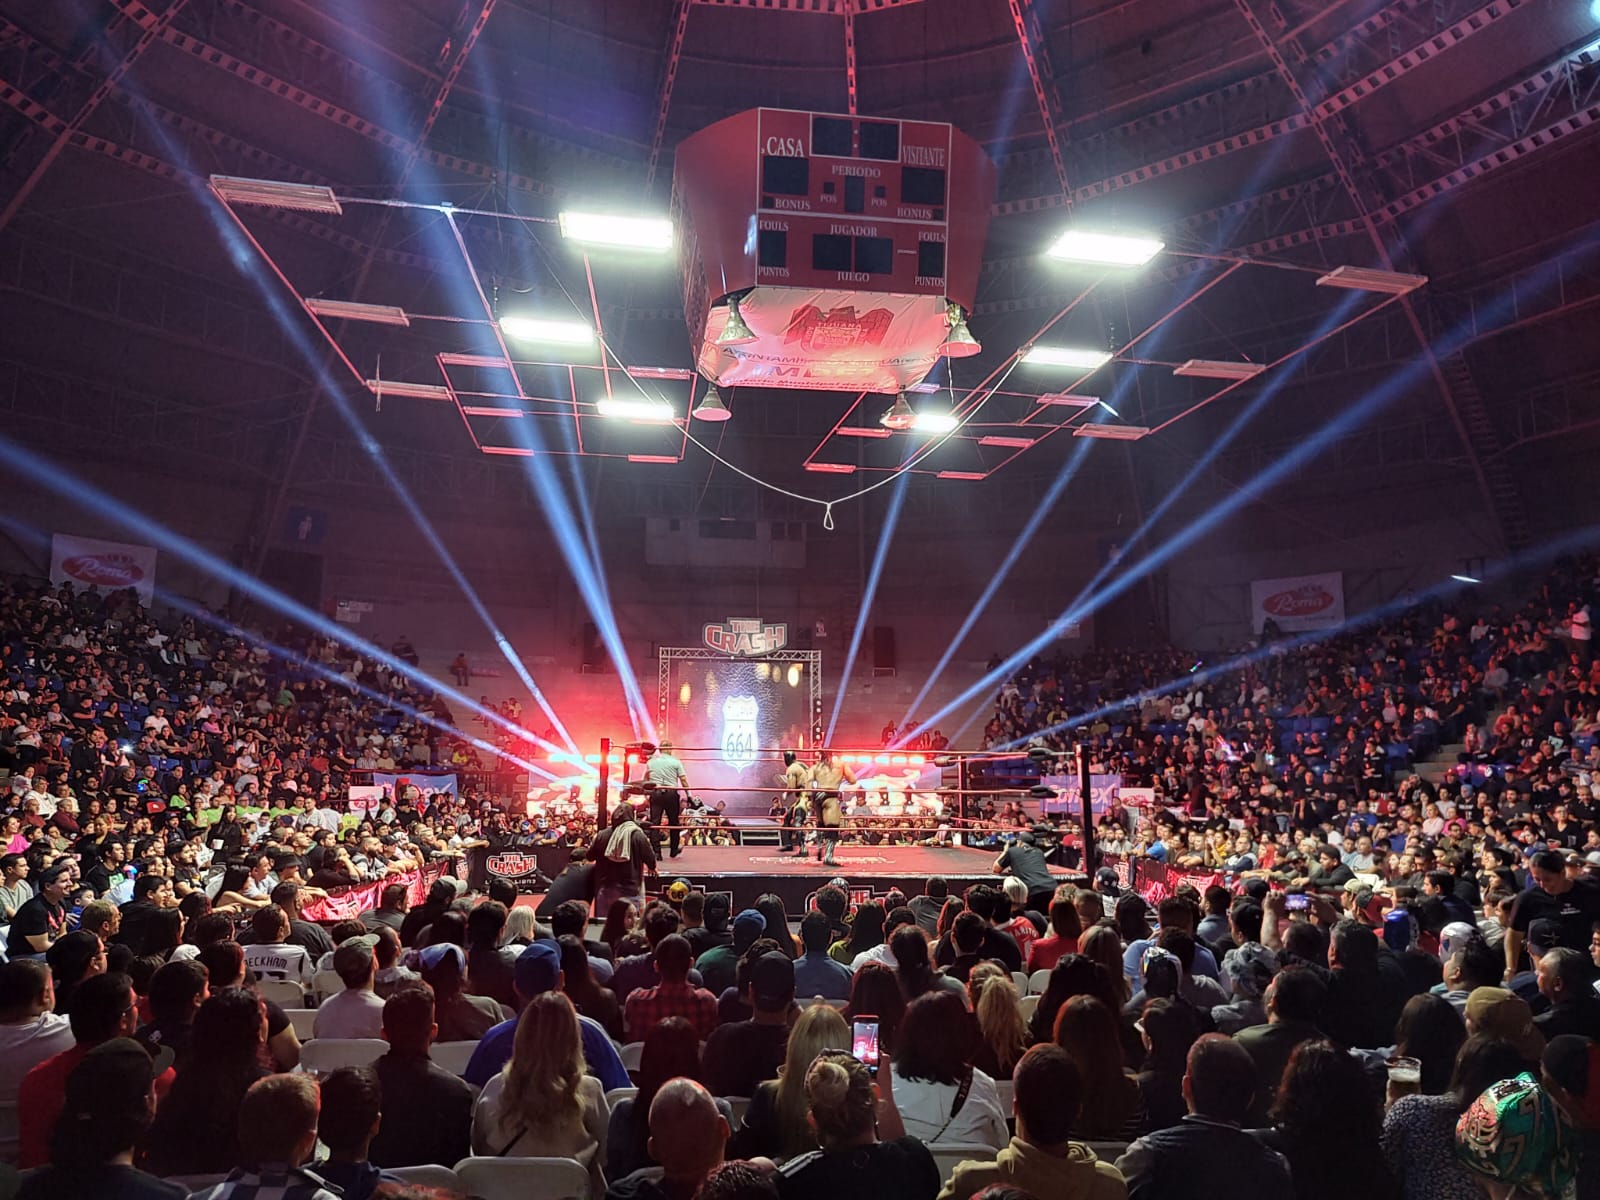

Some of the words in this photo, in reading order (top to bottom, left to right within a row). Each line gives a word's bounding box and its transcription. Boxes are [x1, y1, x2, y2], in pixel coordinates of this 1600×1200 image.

[766, 136, 805, 158] CASA
[902, 145, 945, 167] VISITANTE
[831, 165, 881, 178] PERIODO
[774, 198, 811, 211] BONUS
[819, 193, 837, 204] POS
[870, 197, 888, 208] POS
[896, 207, 932, 220] BONUS
[758, 219, 789, 232] FOULS
[829, 224, 878, 238] JUGADOR
[917, 231, 946, 243] FOULS
[757, 266, 790, 278] PUNTOS
[836, 270, 870, 283] JUEGO
[914, 276, 945, 288] PUNTOS
[729, 620, 762, 633] THE
[704, 625, 786, 655] CRASH
[726, 731, 754, 759] 664
[504, 855, 521, 863] THE
[488, 857, 536, 875] CRASH
